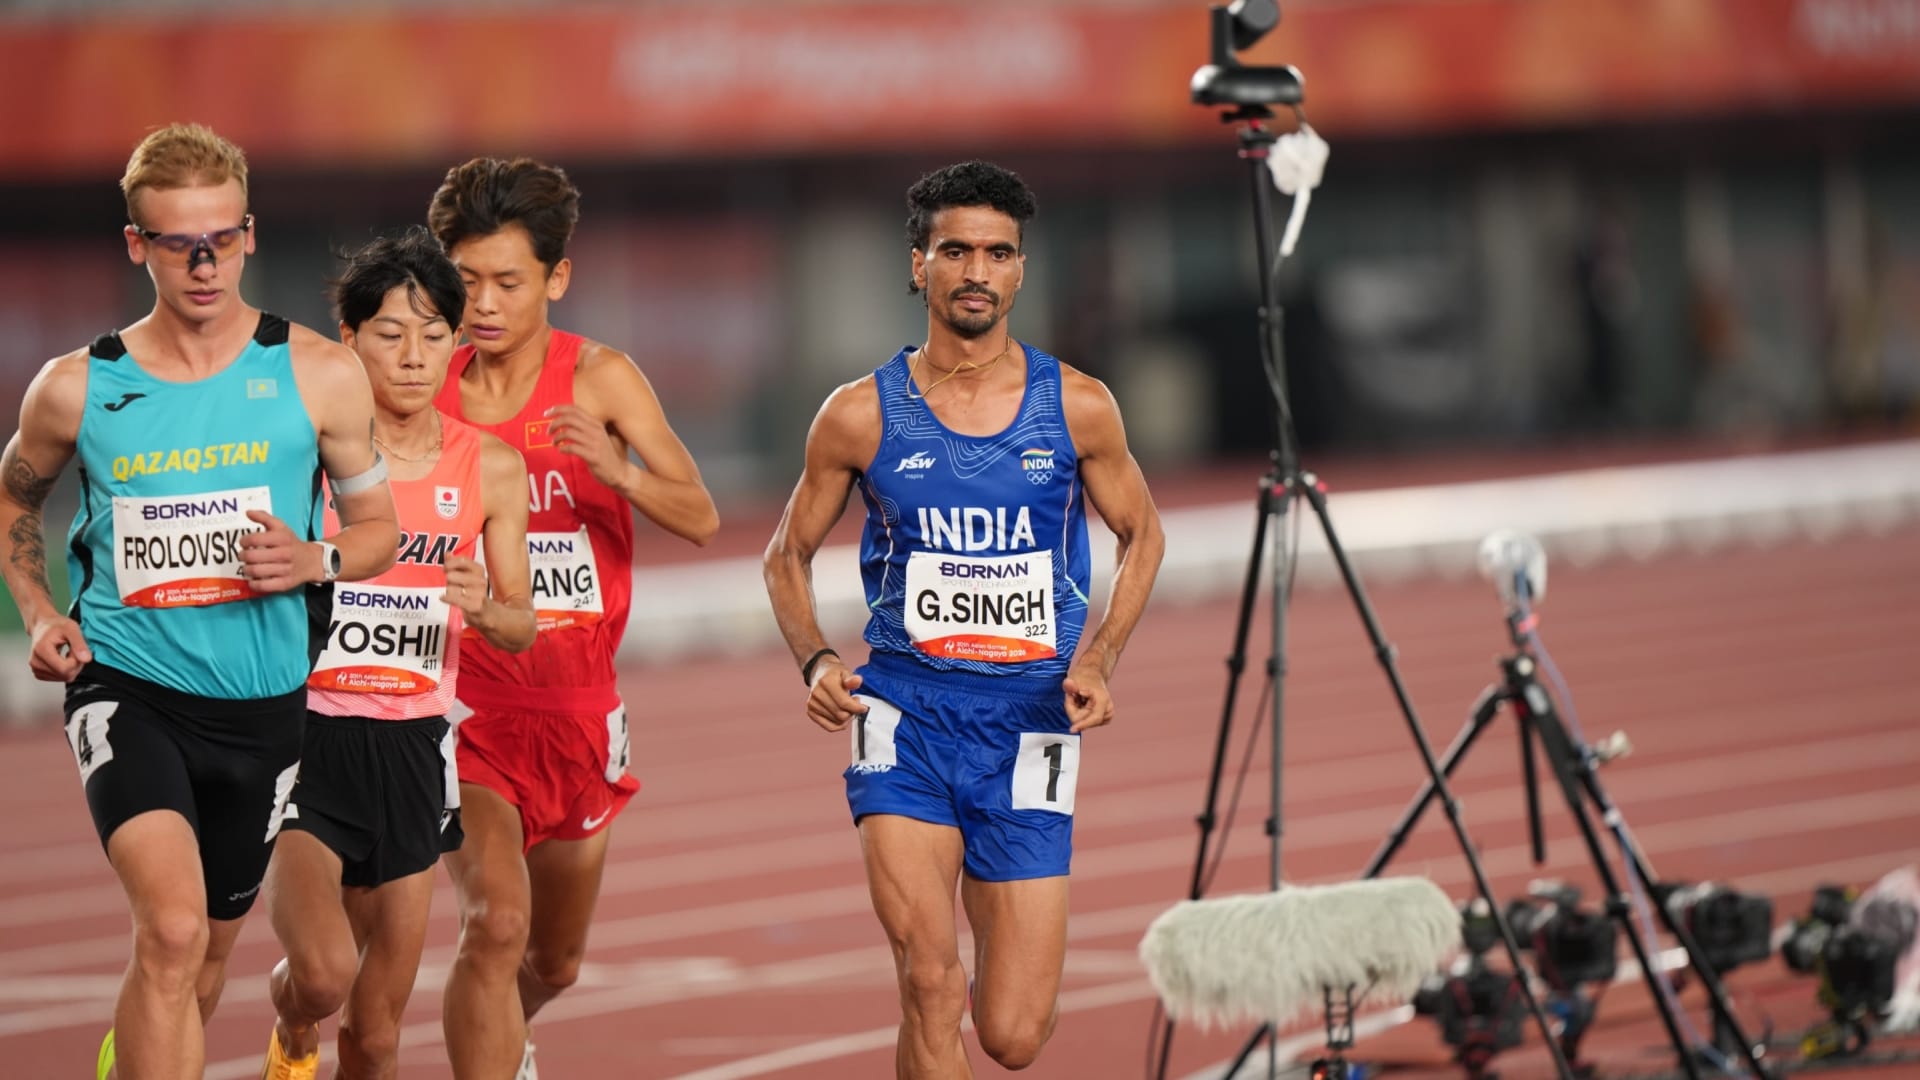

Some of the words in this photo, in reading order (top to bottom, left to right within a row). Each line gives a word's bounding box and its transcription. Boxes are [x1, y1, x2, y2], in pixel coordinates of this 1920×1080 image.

[112, 441, 269, 482] QAZAQSTAN
[893, 451, 937, 472] JSW
[1022, 458, 1055, 470] INDIA
[142, 498, 238, 520] BORNAN
[917, 506, 1036, 551] INDIA
[124, 526, 261, 571] FROLOVSK
[529, 540, 573, 554] NAN
[939, 561, 1028, 579] BORNAN
[532, 564, 593, 599] ANG
[338, 590, 429, 610] BORNAN
[917, 588, 1046, 626] G.SINGH
[1025, 624, 1048, 638] 322
[422, 658, 437, 670] 411
[1043, 743, 1062, 802] 1
